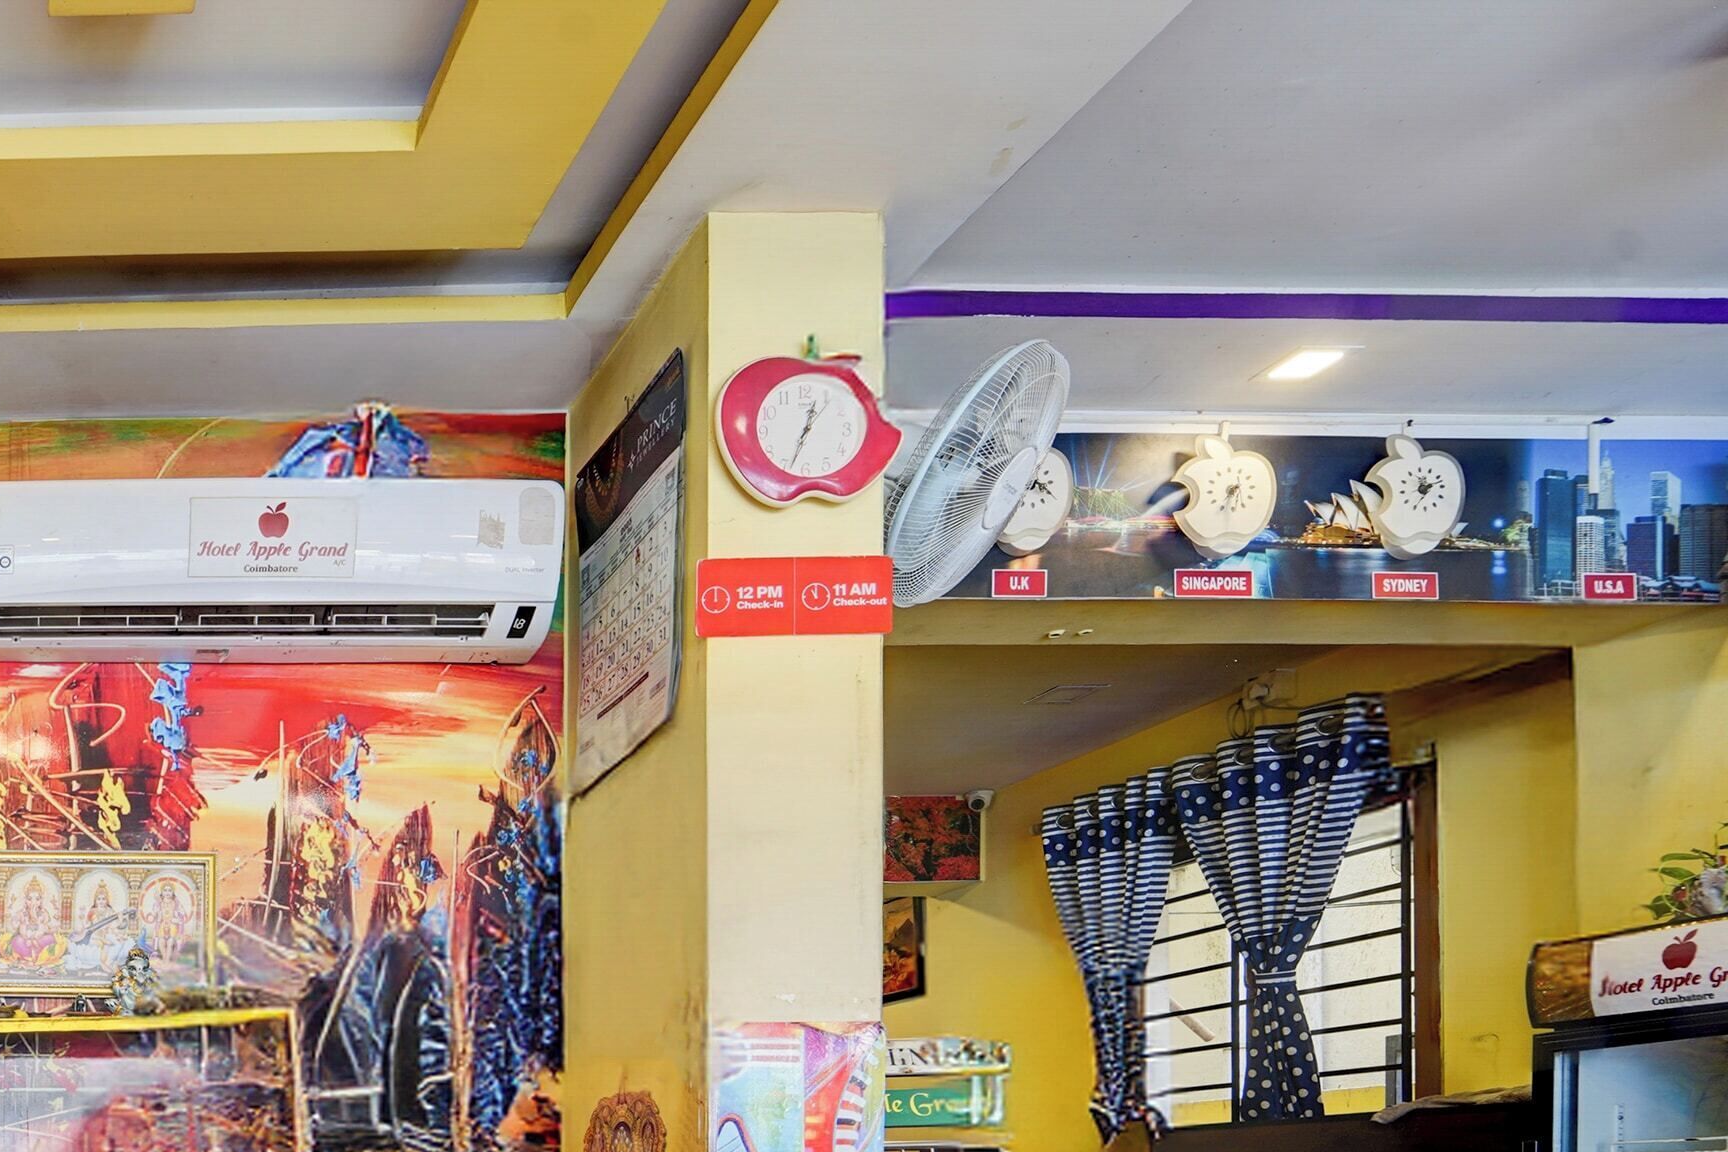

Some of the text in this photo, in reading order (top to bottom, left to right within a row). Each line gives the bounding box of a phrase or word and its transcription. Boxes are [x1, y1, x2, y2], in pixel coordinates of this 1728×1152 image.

[778, 391, 789, 405] 11
[798, 383, 812, 400] 12
[763, 405, 777, 420] 10
[636, 397, 678, 452] PRINCE
[758, 424, 768, 440] 9
[842, 421, 852, 437] 3
[836, 442, 846, 457] 4
[821, 456, 831, 472] 5
[197, 541, 349, 561] Hotel Apple Grand
[244, 564, 299, 573] Coimbatore
[832, 583, 877, 596] 11 AM
[1009, 576, 1030, 591] U.K
[1182, 576, 1247, 591] SINGAPORE
[1383, 578, 1428, 593] SYDNEY
[1594, 579, 1625, 594] U.S.A
[737, 586, 783, 599] 12 PM
[736, 601, 784, 610] Check-in
[832, 597, 887, 606] Check-out
[1651, 972, 1702, 993] Apple
[1652, 991, 1715, 1006] Coimbatore
